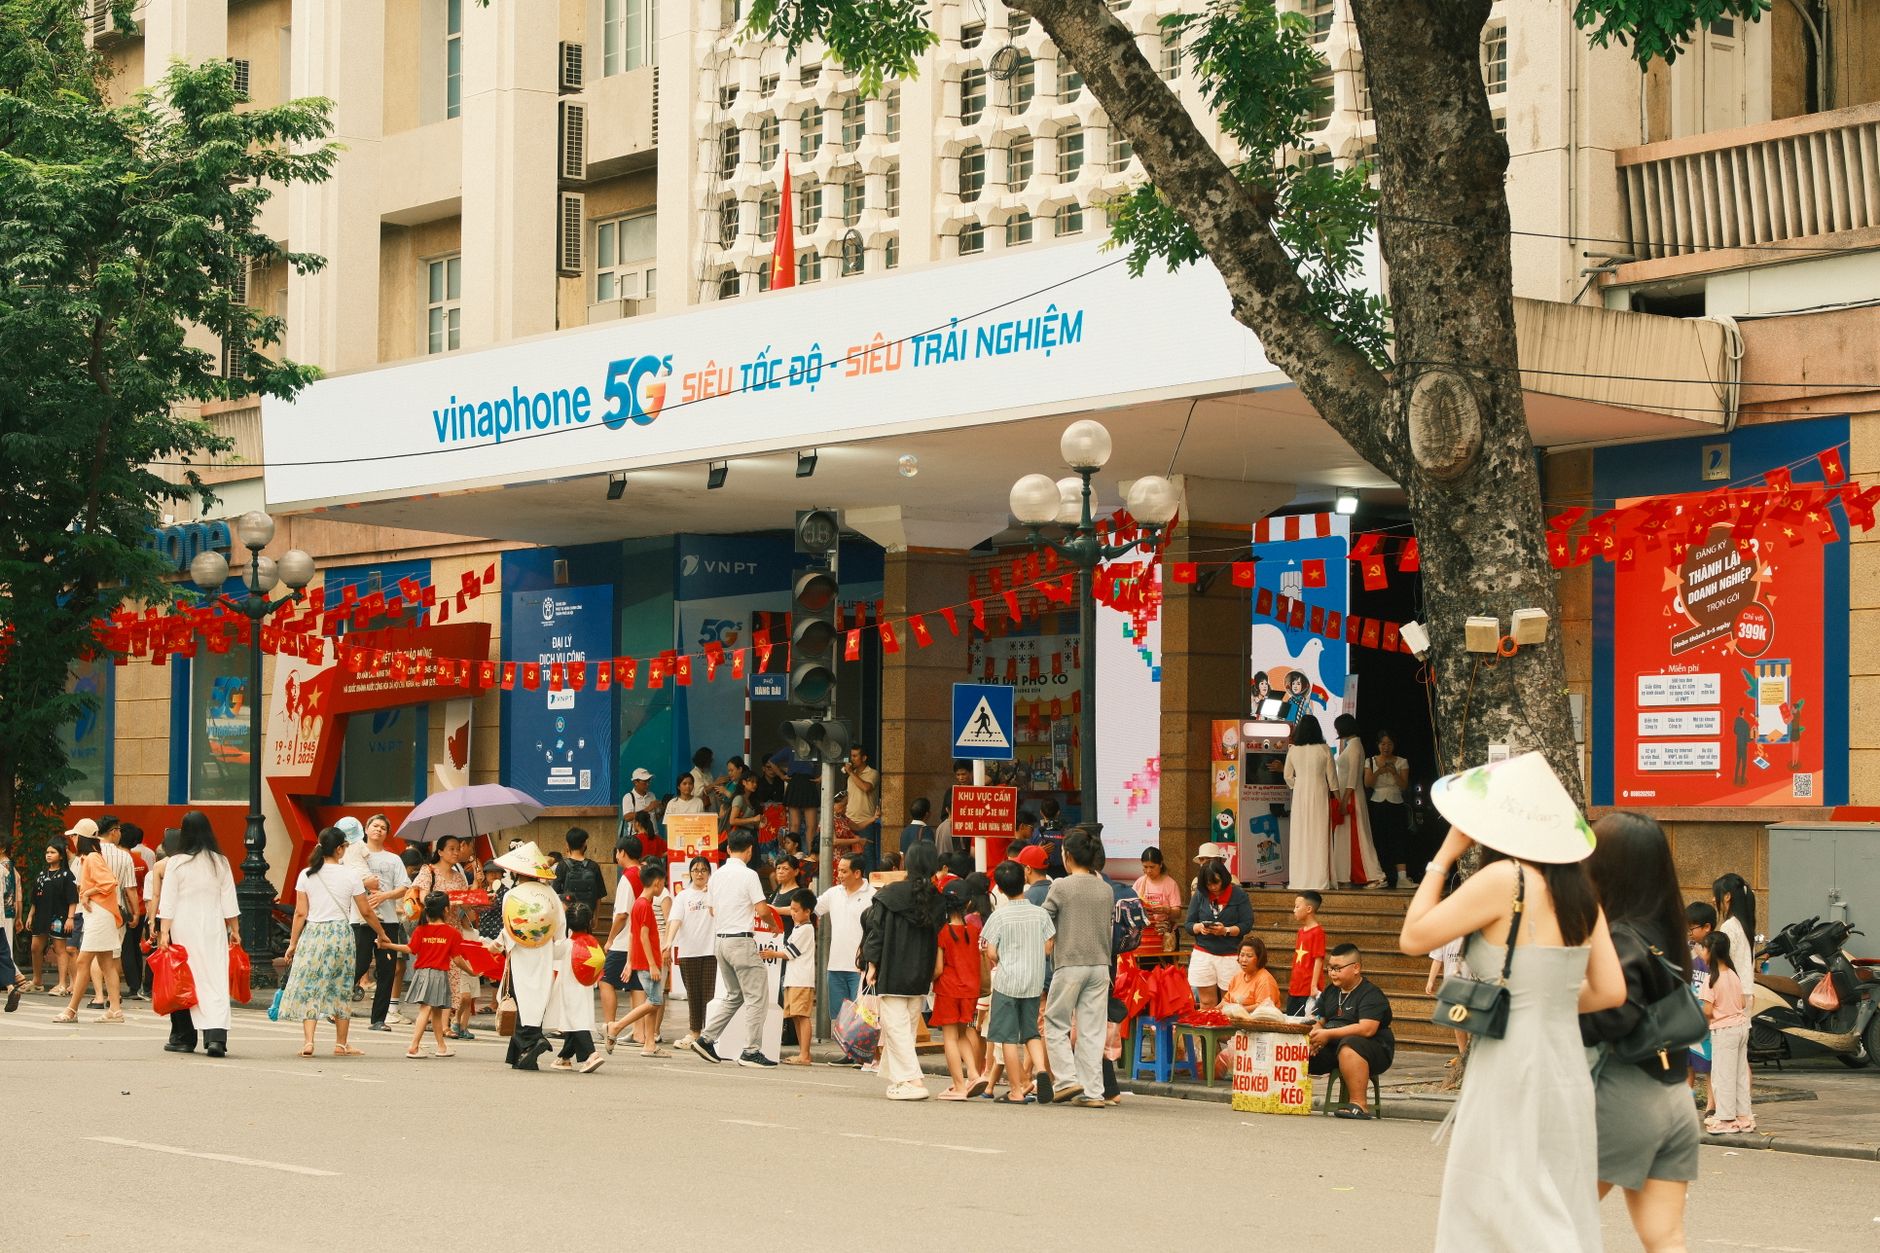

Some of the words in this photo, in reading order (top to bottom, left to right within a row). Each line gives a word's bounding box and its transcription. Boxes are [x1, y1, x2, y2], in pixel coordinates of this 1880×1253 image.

[433, 384, 591, 444] vinaphone
[682, 359, 733, 403] SIÊU
[740, 345, 782, 393] TỐC
[789, 343, 822, 393] ĐỘ
[845, 331, 903, 378] SIÊU
[911, 317, 968, 367] TRẢI
[975, 303, 1084, 359] NGHIỆM
[1696, 544, 1717, 560] ĐĂNG
[704, 560, 758, 575] VNPT
[1688, 559, 1722, 586] THÀNH
[1688, 581, 1718, 605] DOANH
[1719, 566, 1752, 591] NGHIỆP
[1726, 592, 1740, 604] GÓI
[1738, 622, 1767, 641] 399k
[552, 637, 563, 650] ĐẠI
[564, 633, 573, 648] LÝ
[567, 649, 586, 663] CÔNG
[1688, 664, 1699, 673] phí
[300, 741, 316, 752] 1945
[298, 752, 314, 764] 2025
[958, 791, 974, 801] KHU
[976, 792, 992, 803] VỰC
[994, 789, 1011, 802] CẤM
[1280, 1085, 1304, 1105] KÉO
